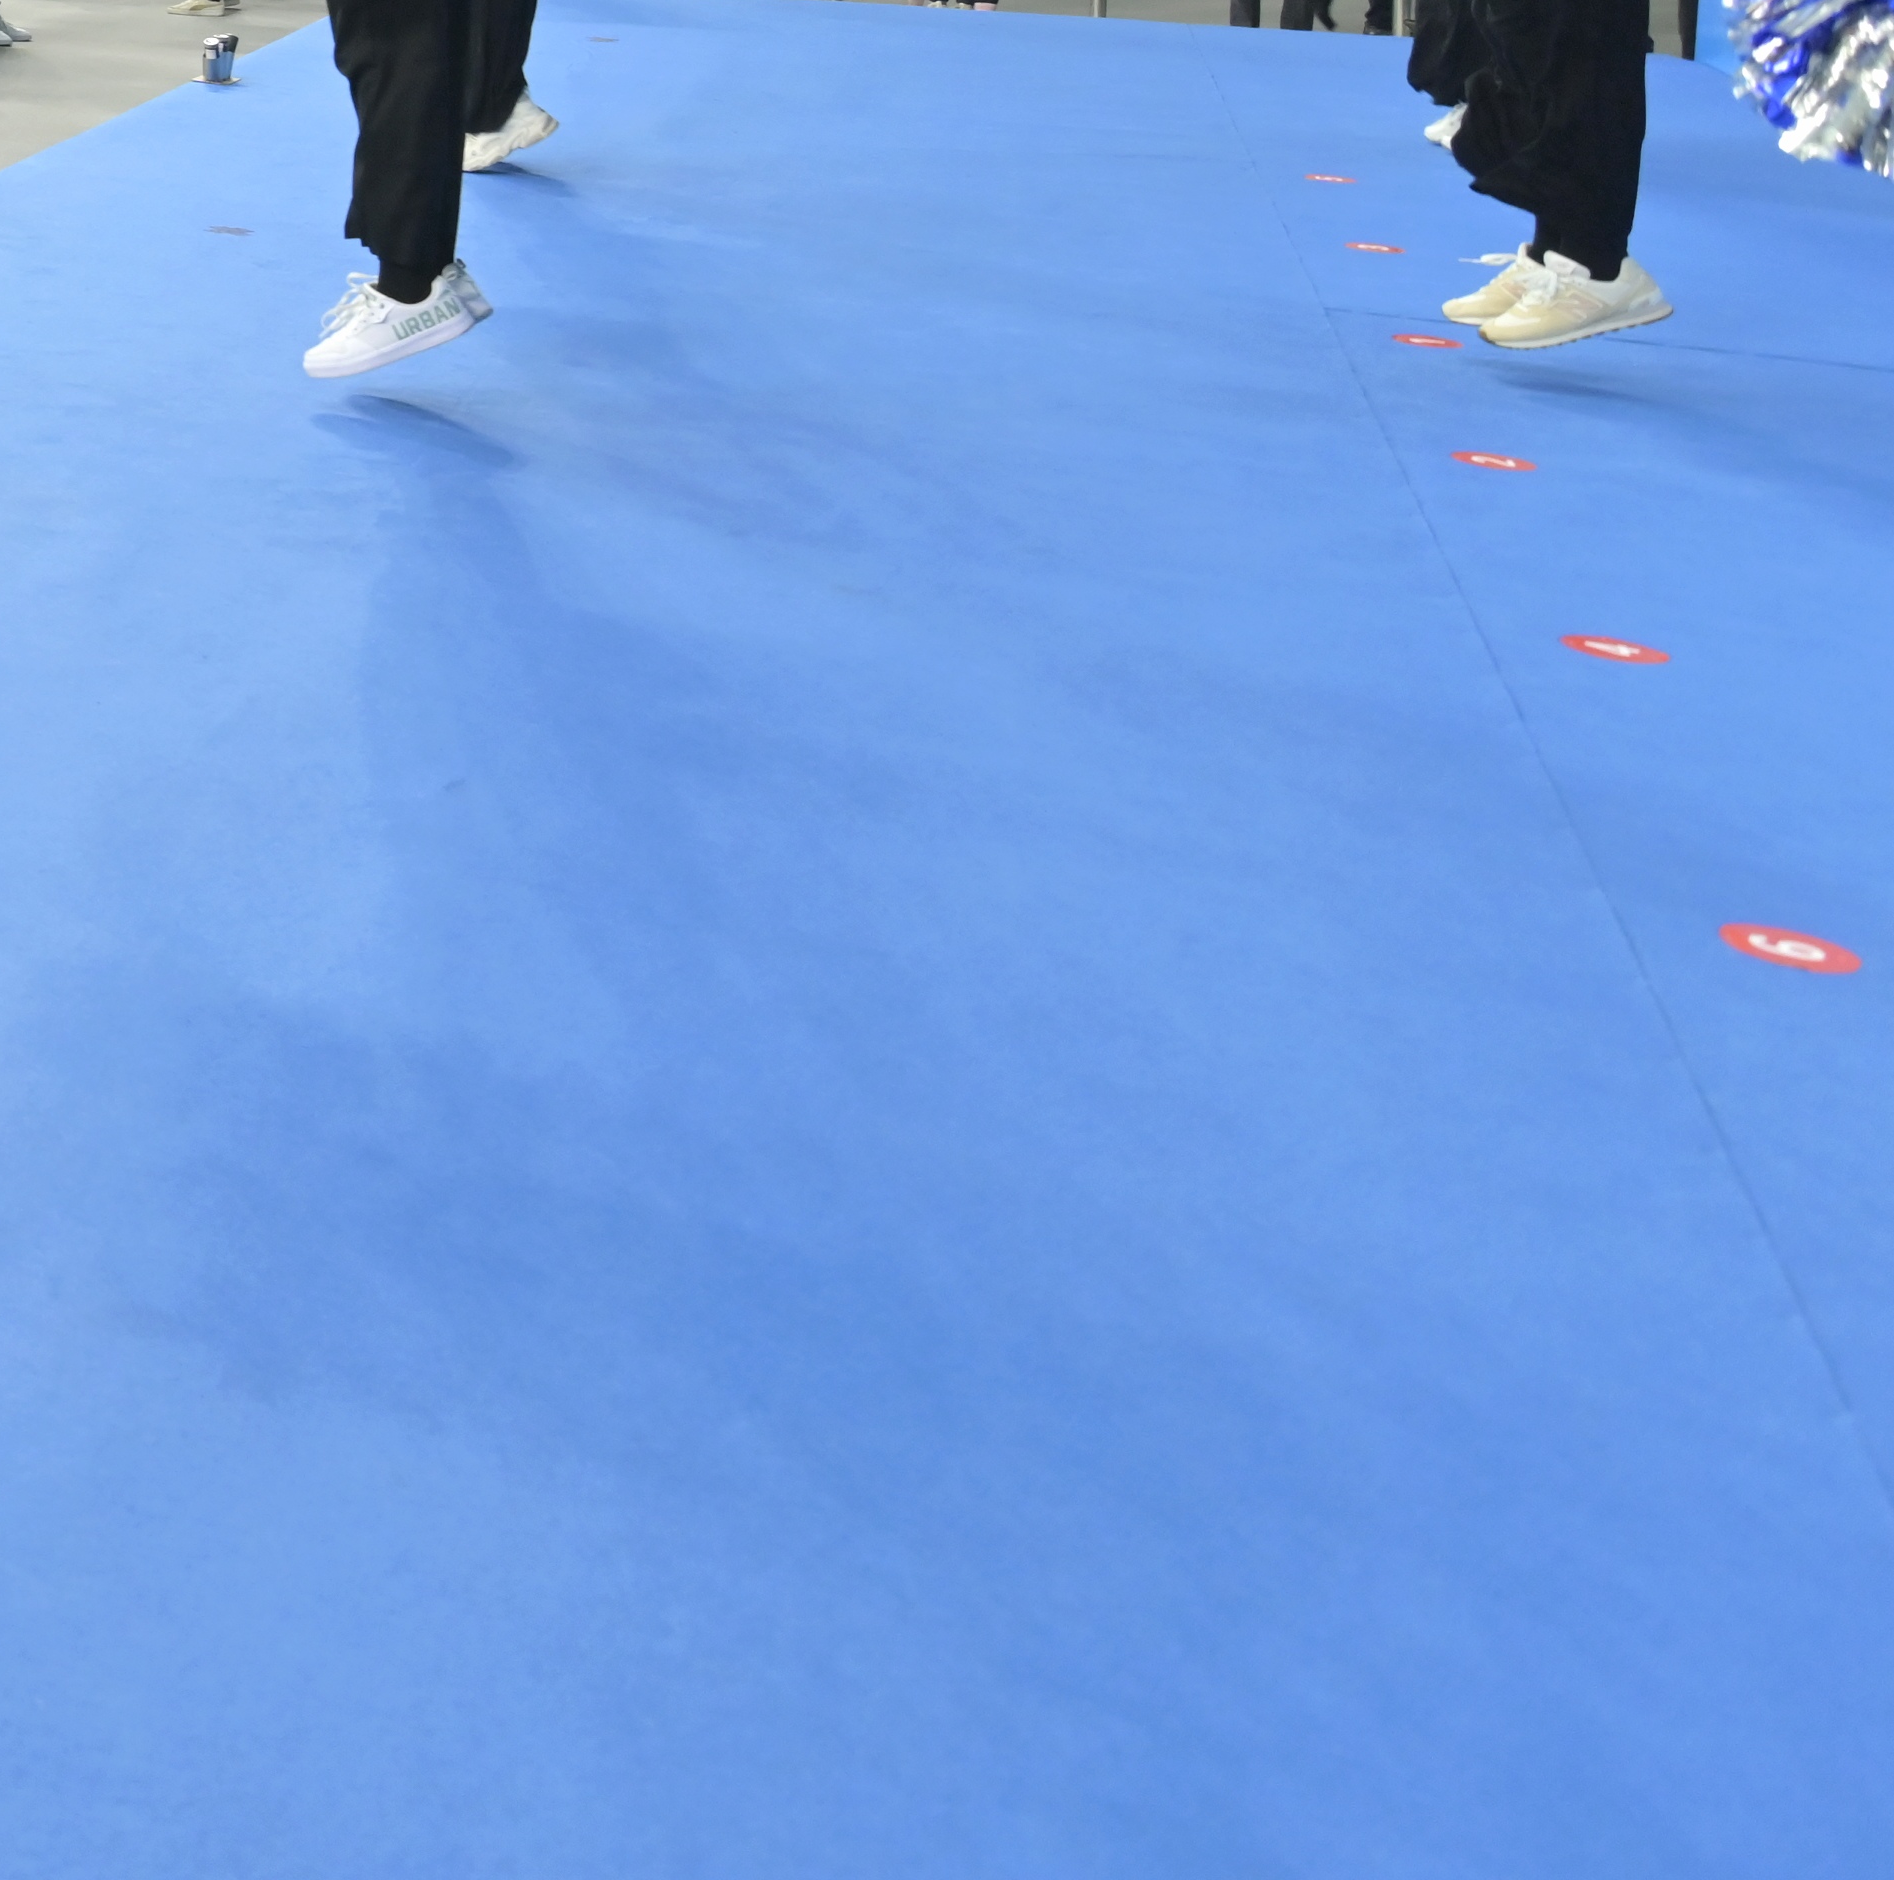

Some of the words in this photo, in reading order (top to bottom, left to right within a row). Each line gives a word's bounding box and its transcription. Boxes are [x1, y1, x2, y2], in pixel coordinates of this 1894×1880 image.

[392, 297, 461, 340] URBAN
[1584, 640, 1640, 657] 4
[1748, 933, 1826, 961] 6
